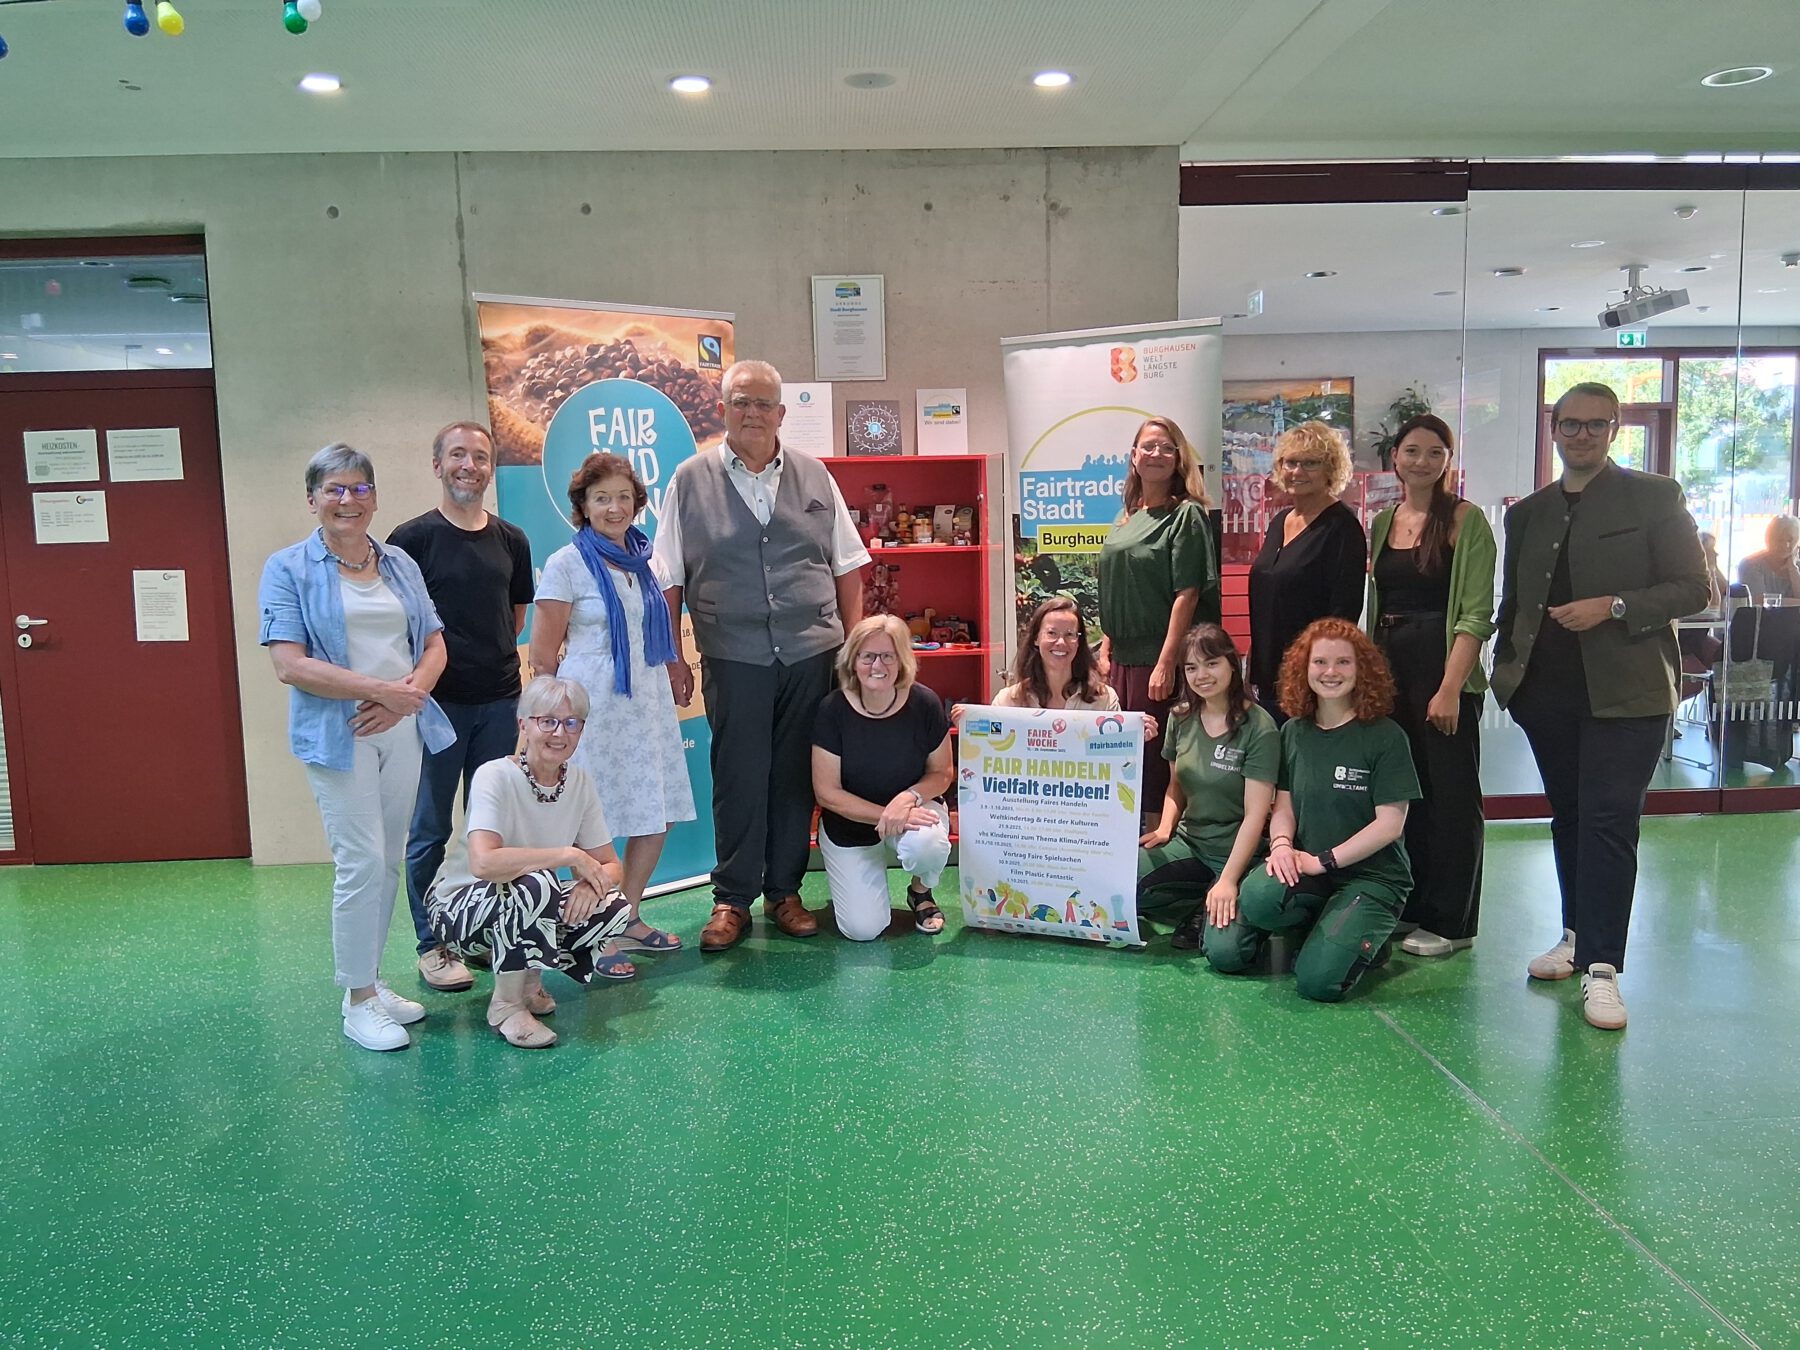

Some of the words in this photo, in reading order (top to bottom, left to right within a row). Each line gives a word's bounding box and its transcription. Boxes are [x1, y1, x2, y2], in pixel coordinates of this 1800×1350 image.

[1143, 343, 1196, 354] BURGHAUSEN
[1144, 355, 1162, 363] WELT
[1143, 371, 1164, 379] BURG
[588, 407, 657, 446] FAIR
[1022, 499, 1085, 520] Stadt
[1027, 729, 1053, 738] FAIRE
[1027, 738, 1057, 748] WOCHE
[1089, 741, 1133, 750] #fairhandeln
[983, 756, 1022, 775] FAIR
[1026, 758, 1110, 781] HANDELN
[982, 776, 1039, 795] Vielfalt
[1042, 780, 1110, 800] erleben!
[1002, 796, 1039, 805] Ausstellung
[989, 813, 1034, 823] Weltkindertag
[1070, 819, 1099, 827] Kulturen
[990, 832, 1020, 840] Kinderuni
[1036, 835, 1058, 843] Thema
[1059, 837, 1110, 847] Klima/Fairtrade
[1003, 850, 1026, 859] Vortrag
[1044, 854, 1082, 863] Spielsachen
[1010, 868, 1024, 876] Film
[1024, 870, 1045, 878] Plastic
[1046, 872, 1074, 881] Fantastic
